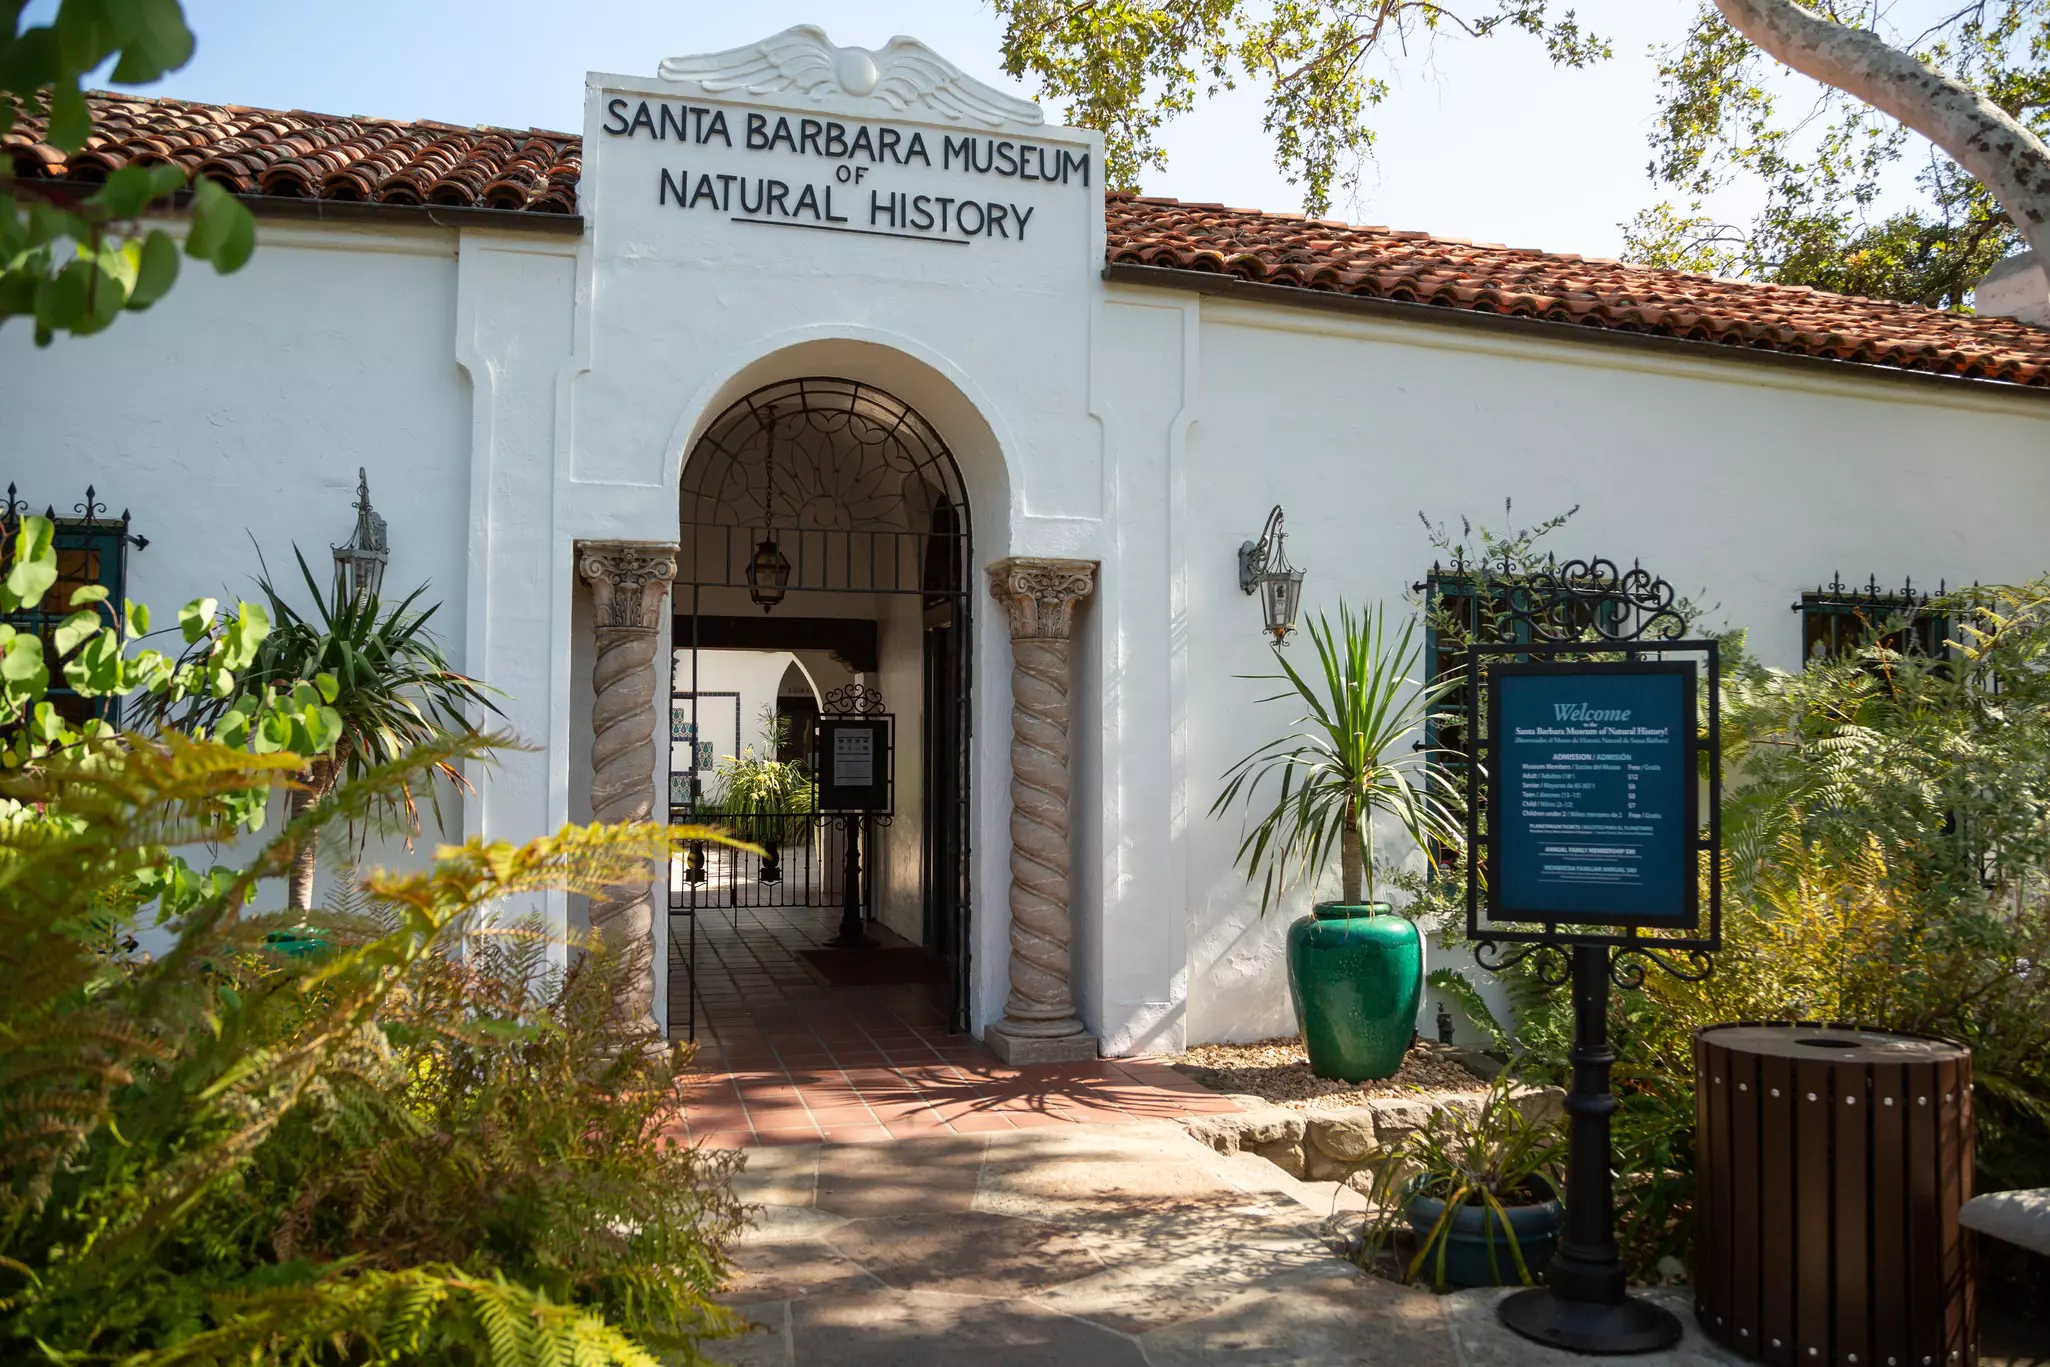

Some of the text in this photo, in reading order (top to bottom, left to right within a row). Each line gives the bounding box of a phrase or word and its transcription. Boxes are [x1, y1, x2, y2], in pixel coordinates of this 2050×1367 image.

[603, 99, 1089, 187] SANTA BARBARA MUSEUM
[835, 164, 869, 185] OF
[659, 167, 1034, 241] NATURAL HISTORY
[1553, 702, 1631, 721] Welcome
[1515, 727, 1668, 737] Santa Barbara Museum of Natural History!
